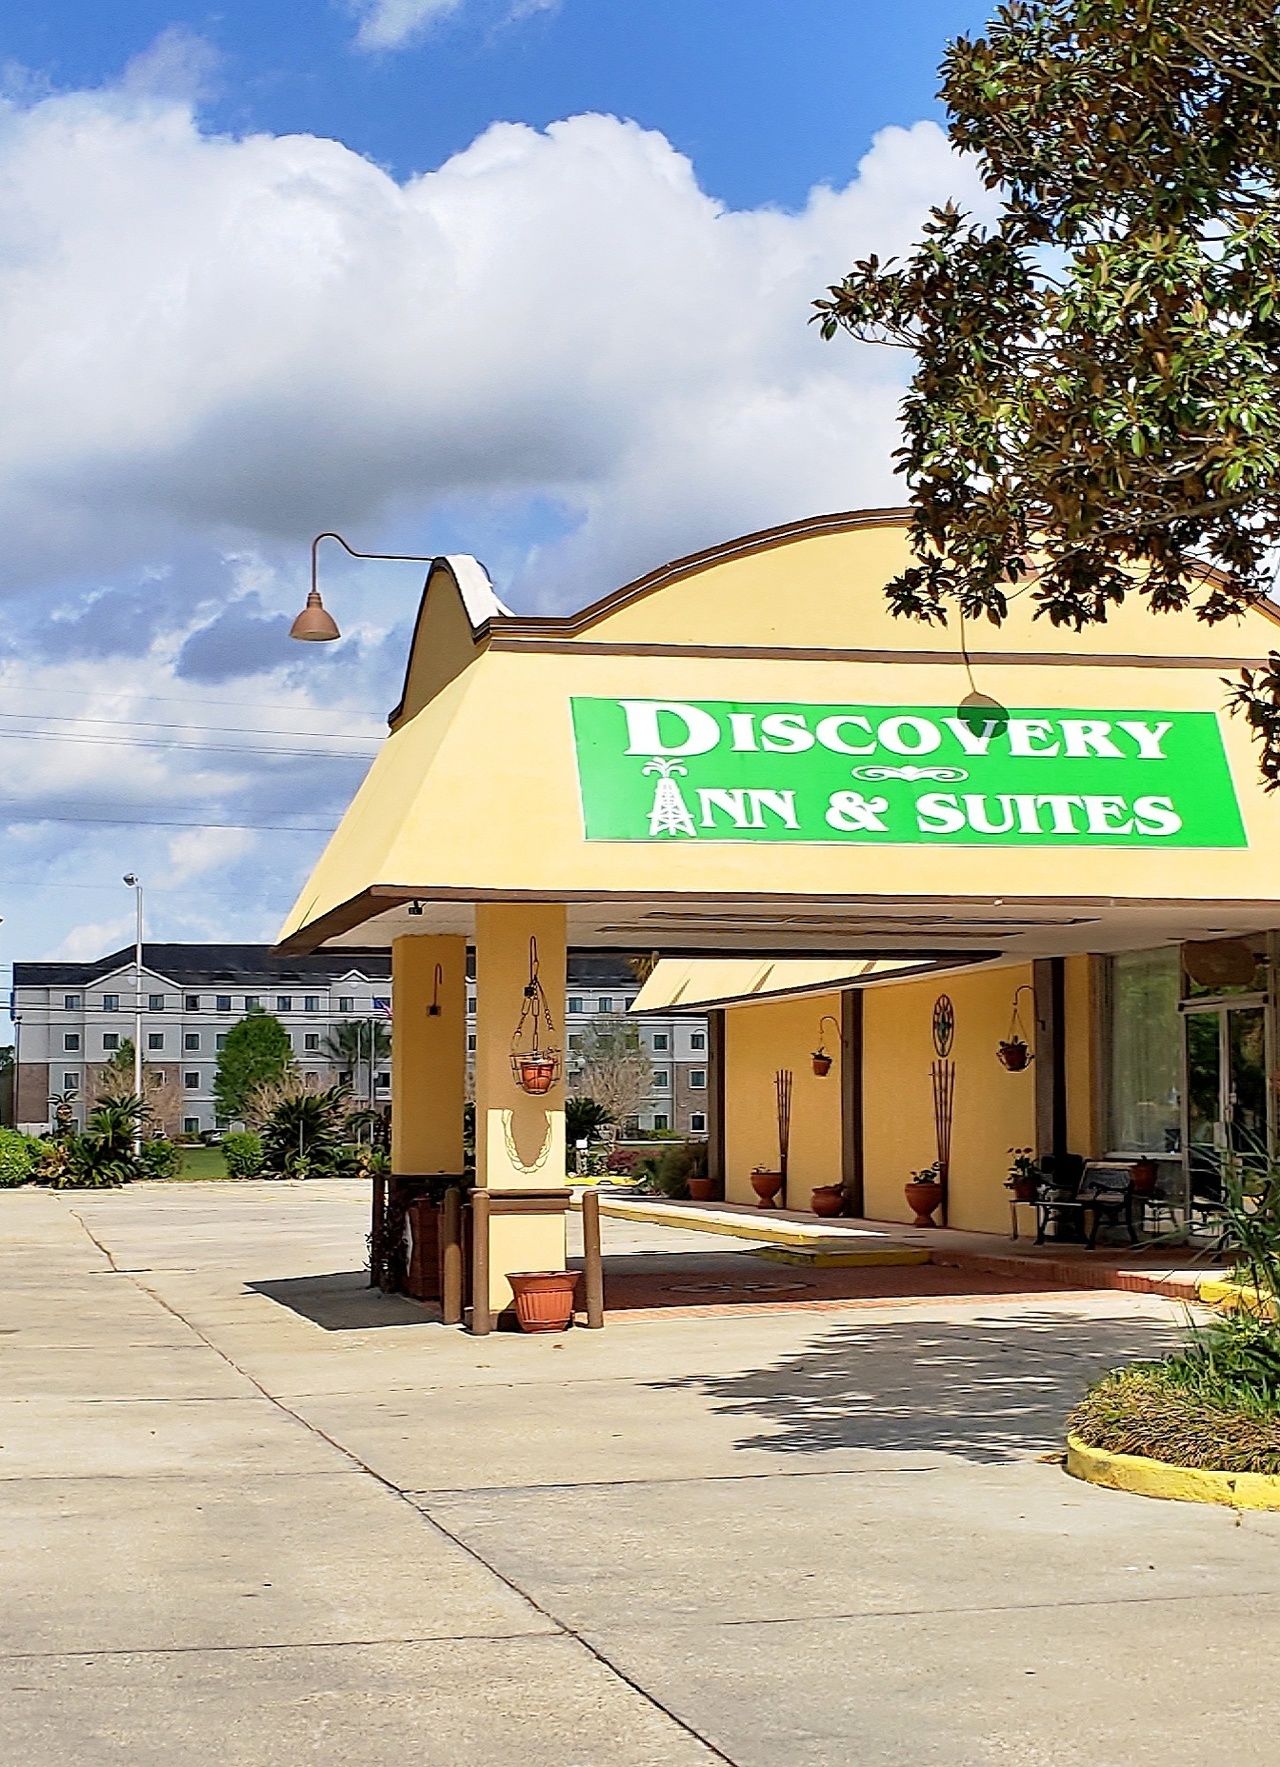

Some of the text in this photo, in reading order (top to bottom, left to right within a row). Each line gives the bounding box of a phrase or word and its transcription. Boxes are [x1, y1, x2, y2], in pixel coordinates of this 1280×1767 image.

[616, 699, 1175, 760] DISCOVERY
[824, 789, 890, 833] &
[915, 792, 1183, 836] SUITES
